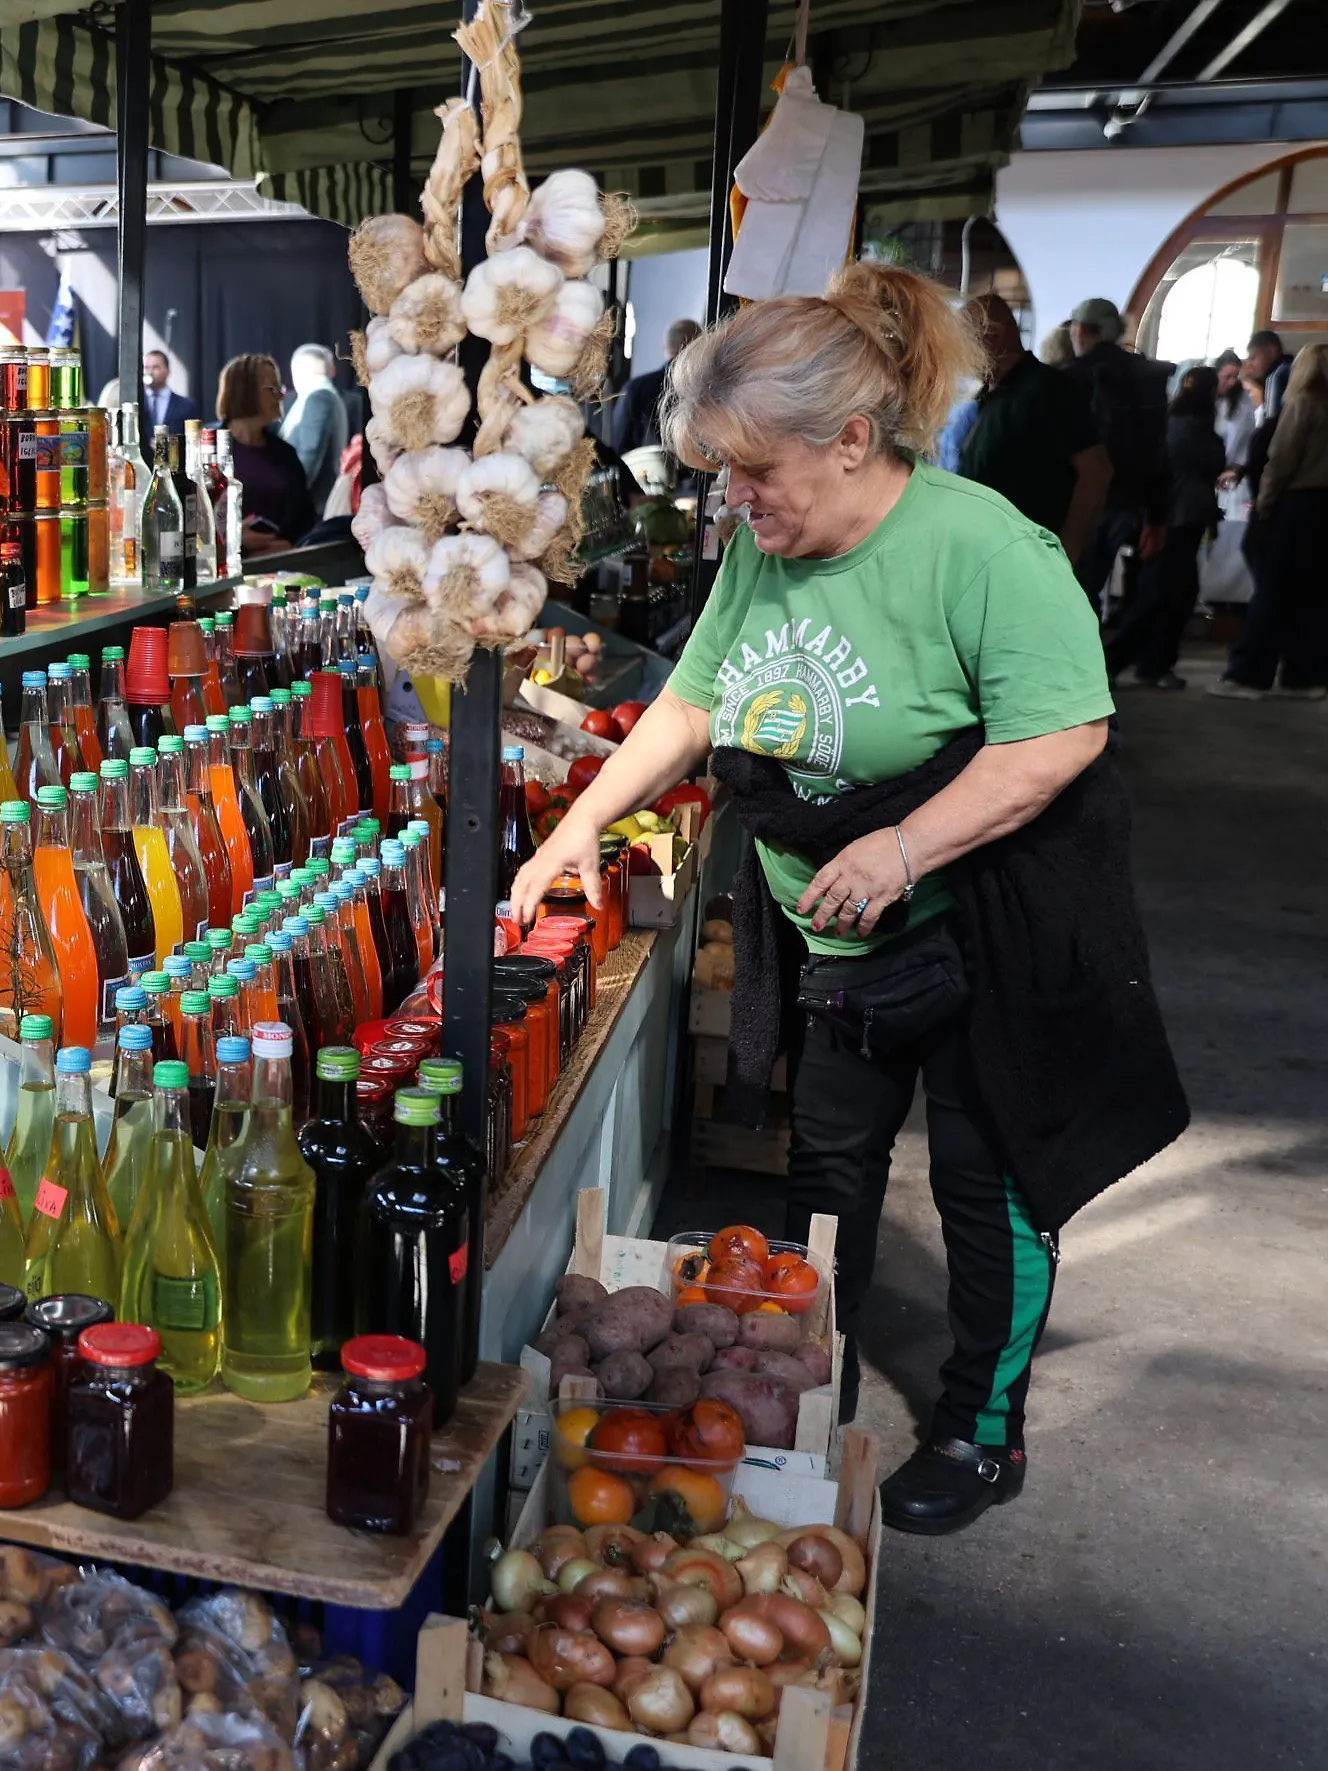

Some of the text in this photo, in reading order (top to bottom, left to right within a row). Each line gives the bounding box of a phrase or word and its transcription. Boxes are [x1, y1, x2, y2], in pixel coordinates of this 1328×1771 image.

[723, 685, 750, 723] SINCE
[757, 663, 791, 687] 1897
[796, 662, 834, 725] HAMMARBY
